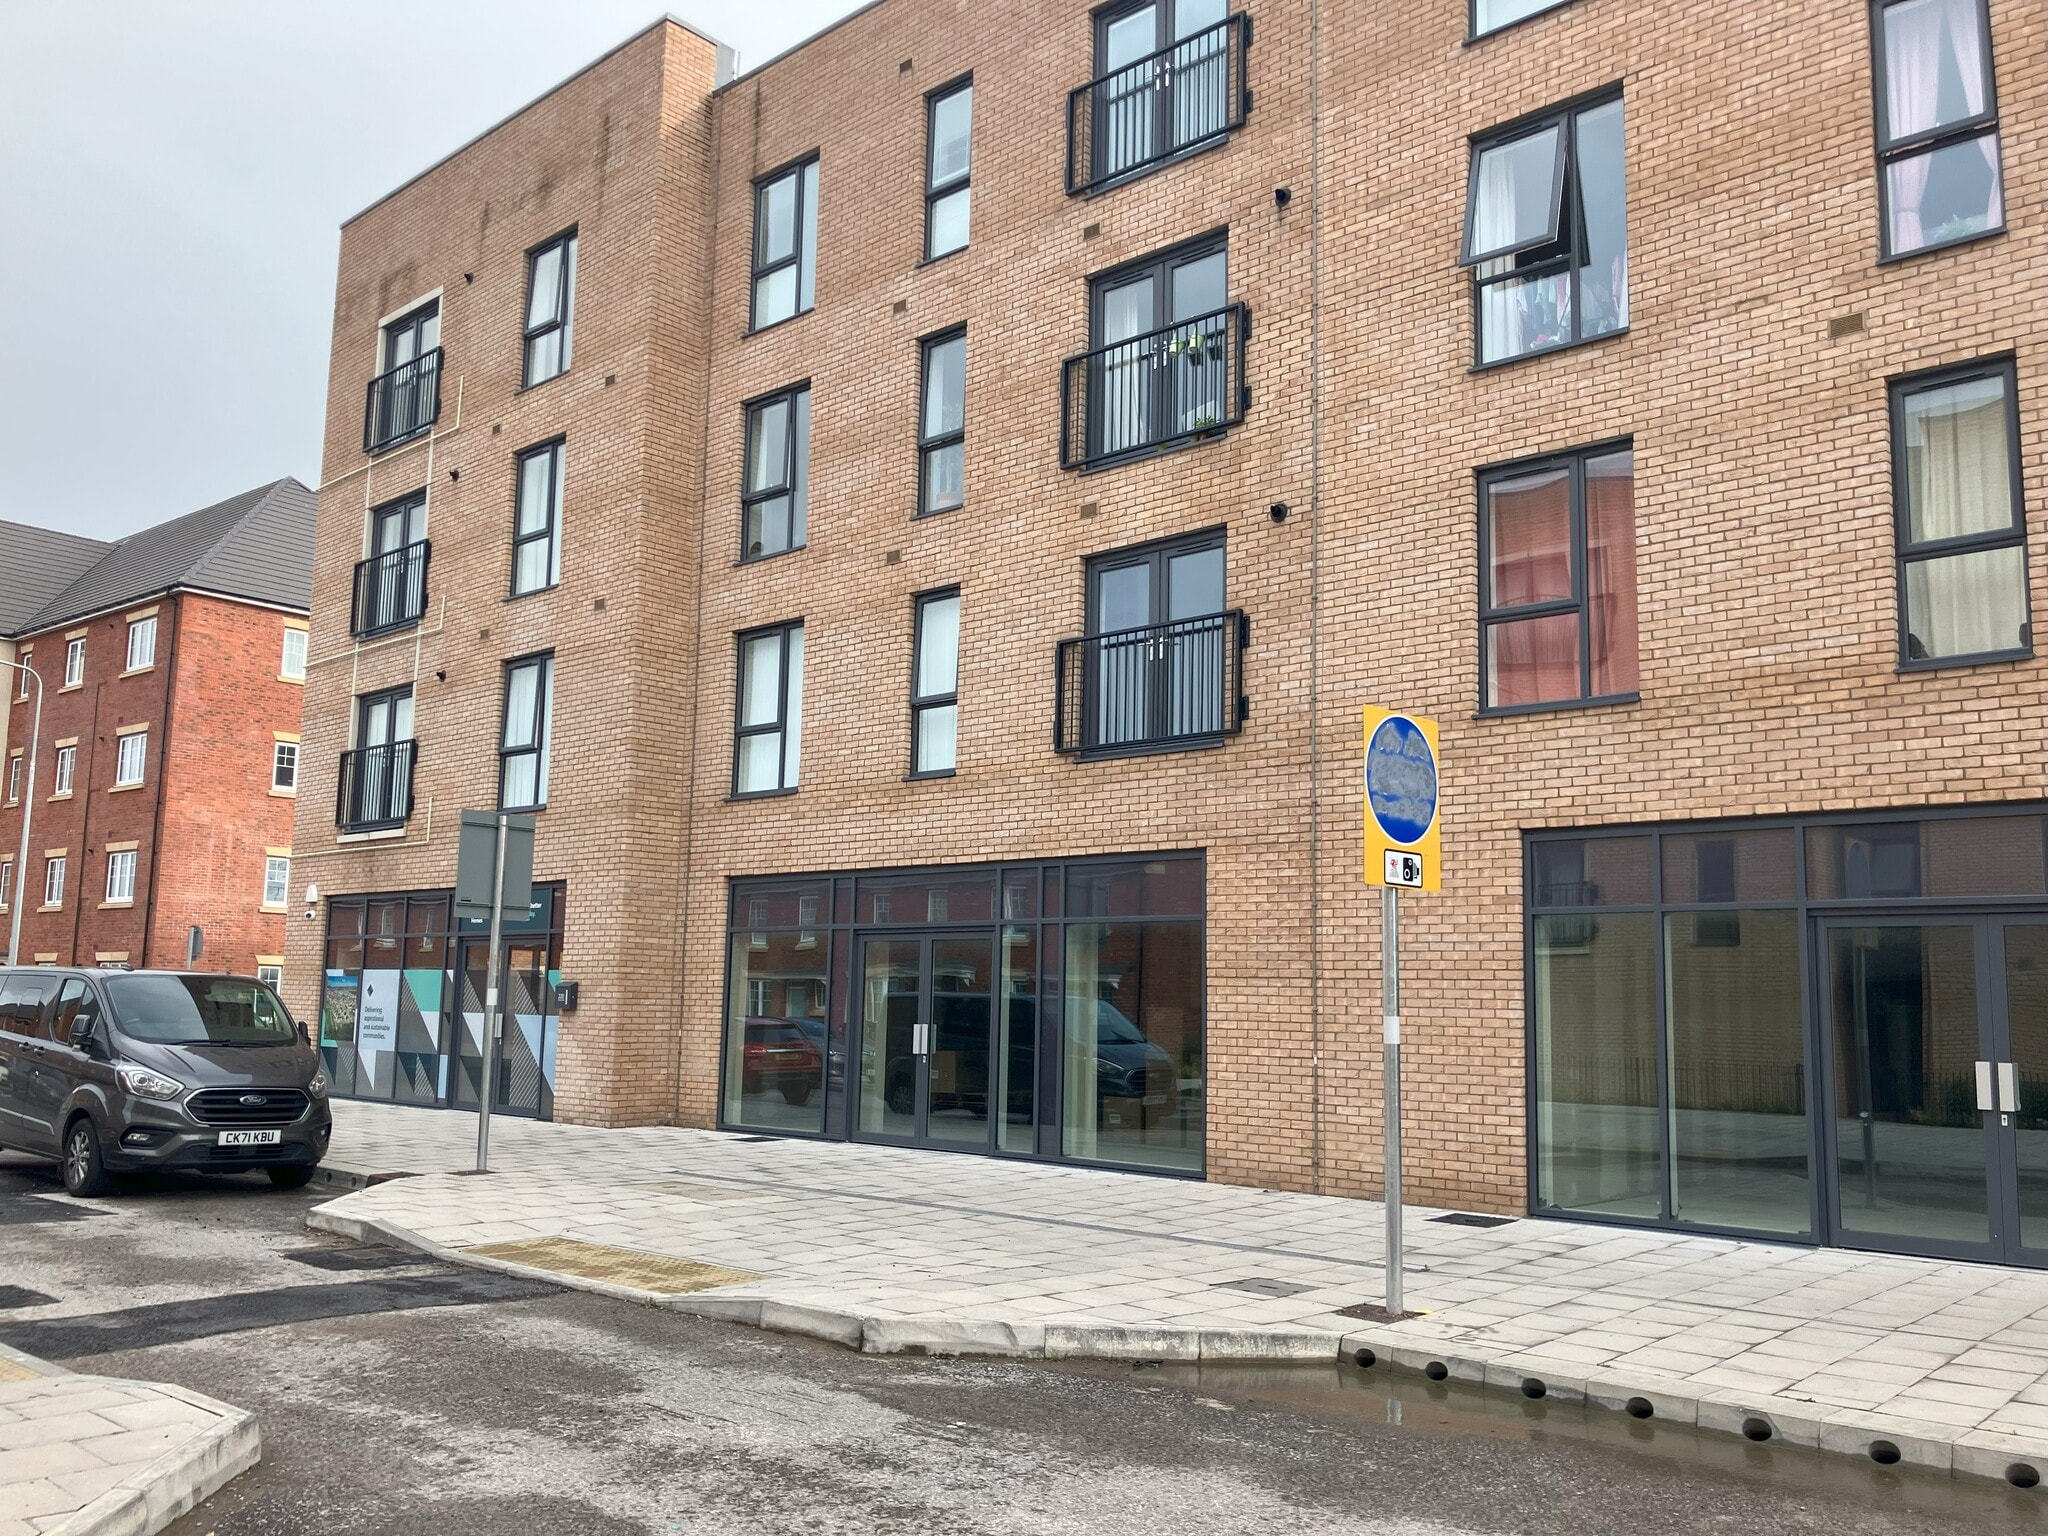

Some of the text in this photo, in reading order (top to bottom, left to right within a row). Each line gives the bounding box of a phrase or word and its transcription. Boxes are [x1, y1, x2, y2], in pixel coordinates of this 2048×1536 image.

[364, 1006, 382, 1014] Delivering
[225, 1131, 275, 1144] CK71 KBU
